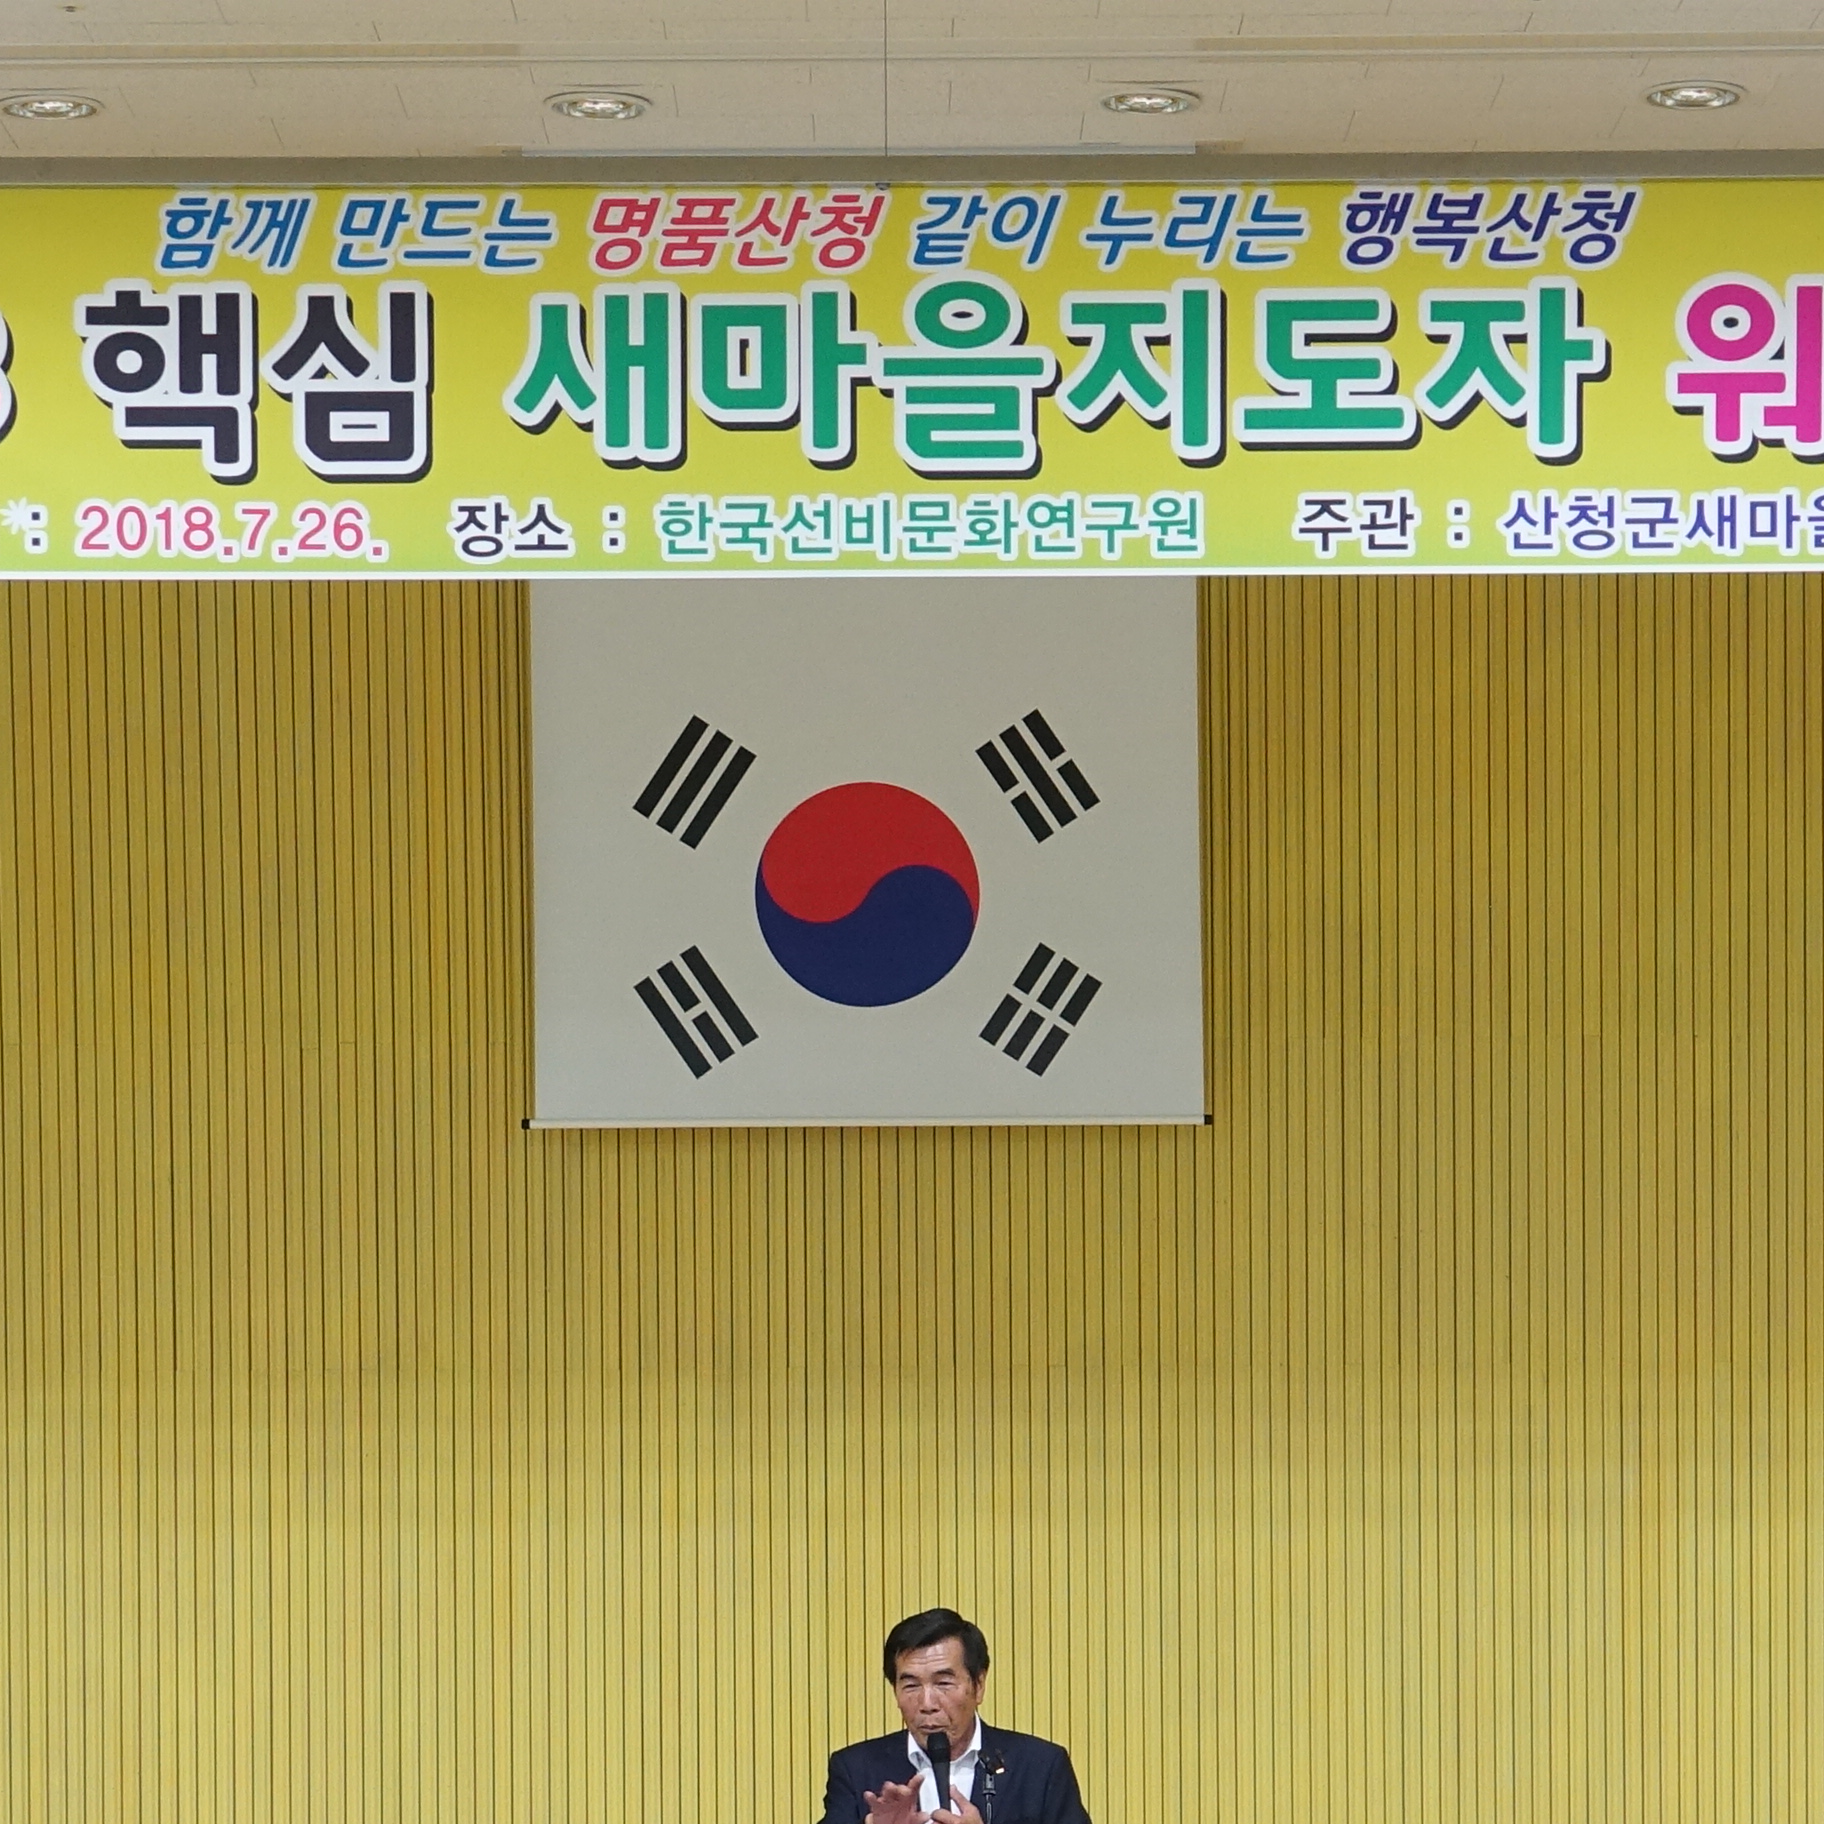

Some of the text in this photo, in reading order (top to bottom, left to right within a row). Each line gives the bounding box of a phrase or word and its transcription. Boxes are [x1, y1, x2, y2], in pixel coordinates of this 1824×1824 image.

[159, 191, 1637, 269] 함께 만드는 명품산청 같이 누리는 행복산청
[82, 287, 415, 465] 핵심
[511, 280, 1595, 460] 새마을지도자
[80, 505, 383, 556] 2018.7.26.
[452, 501, 571, 556] 장소
[658, 497, 1201, 555] 한국선비문화연구원
[1297, 496, 1415, 552] 주관
